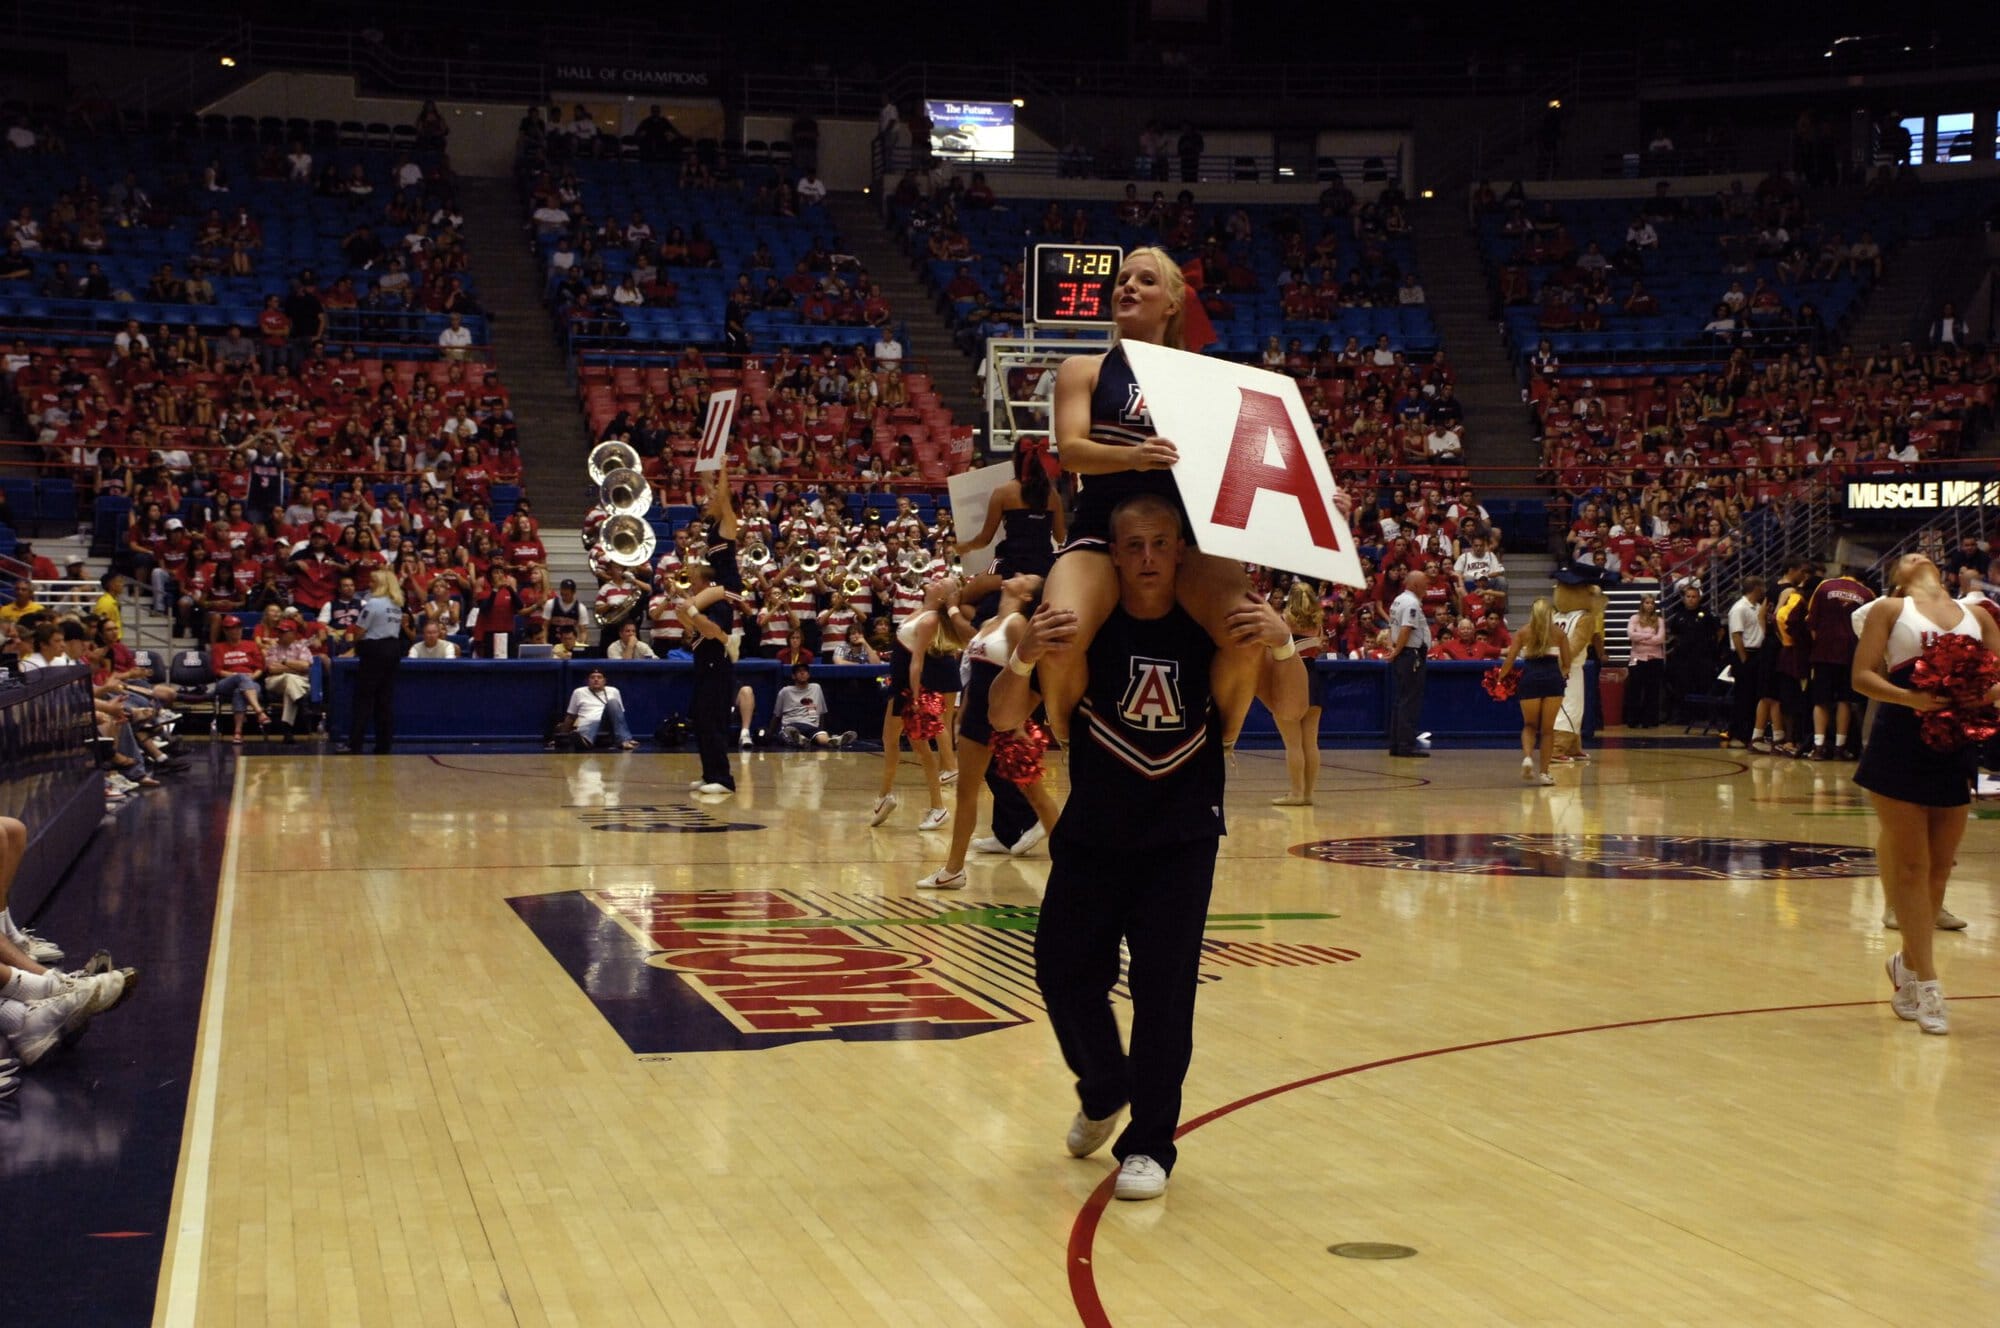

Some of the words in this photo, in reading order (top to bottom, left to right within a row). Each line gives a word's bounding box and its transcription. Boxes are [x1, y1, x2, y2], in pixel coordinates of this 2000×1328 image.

[557, 65, 593, 80] HALL
[600, 67, 618, 80] OF
[622, 69, 709, 85] CHAMPIONS
[944, 104, 960, 113] The
[1063, 253, 1112, 275] 7:28
[1056, 282, 1101, 316] 35
[746, 359, 759, 370] 21
[701, 399, 732, 460] U
[1210, 386, 1341, 552] A
[1848, 482, 1938, 510] MUSCLE
[1117, 655, 1186, 731] A
